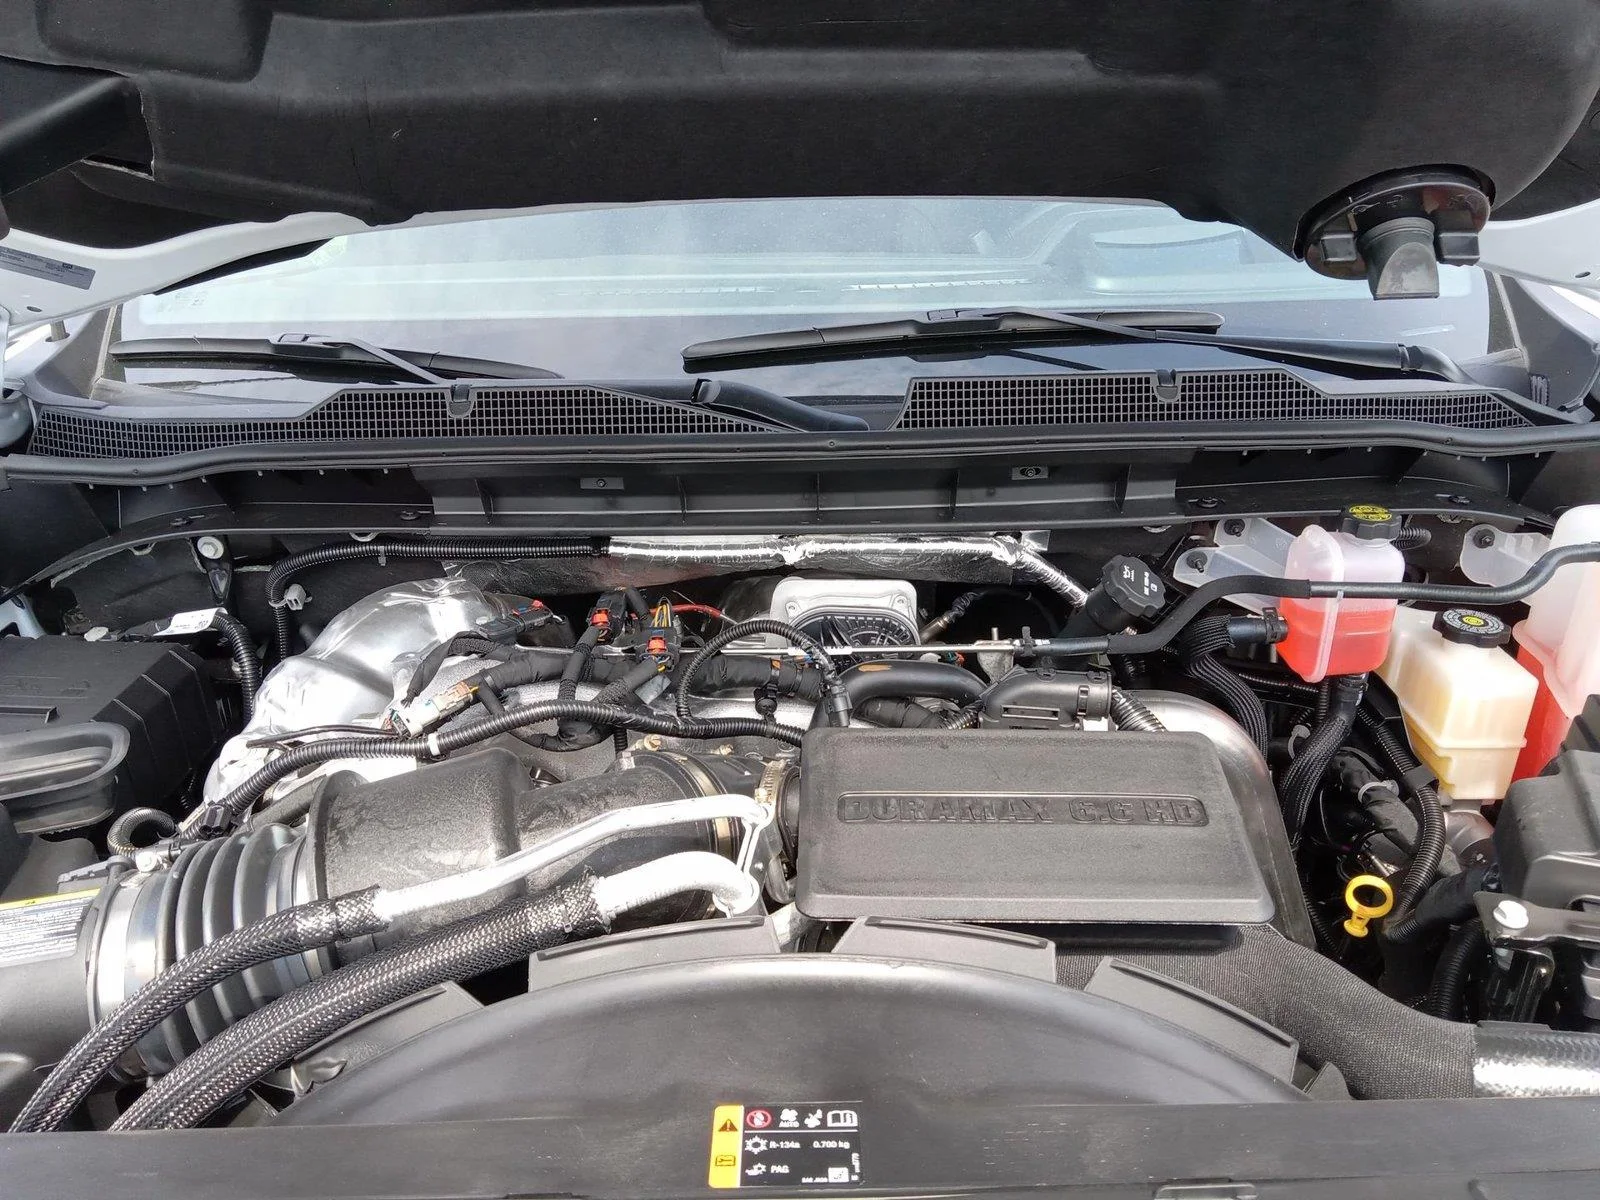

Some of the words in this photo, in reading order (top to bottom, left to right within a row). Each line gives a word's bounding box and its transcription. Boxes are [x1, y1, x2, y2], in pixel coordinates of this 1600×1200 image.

[842, 797, 1054, 822] DURAMAX
[1142, 799, 1204, 825] HD
[838, 1141, 851, 1150] kg
